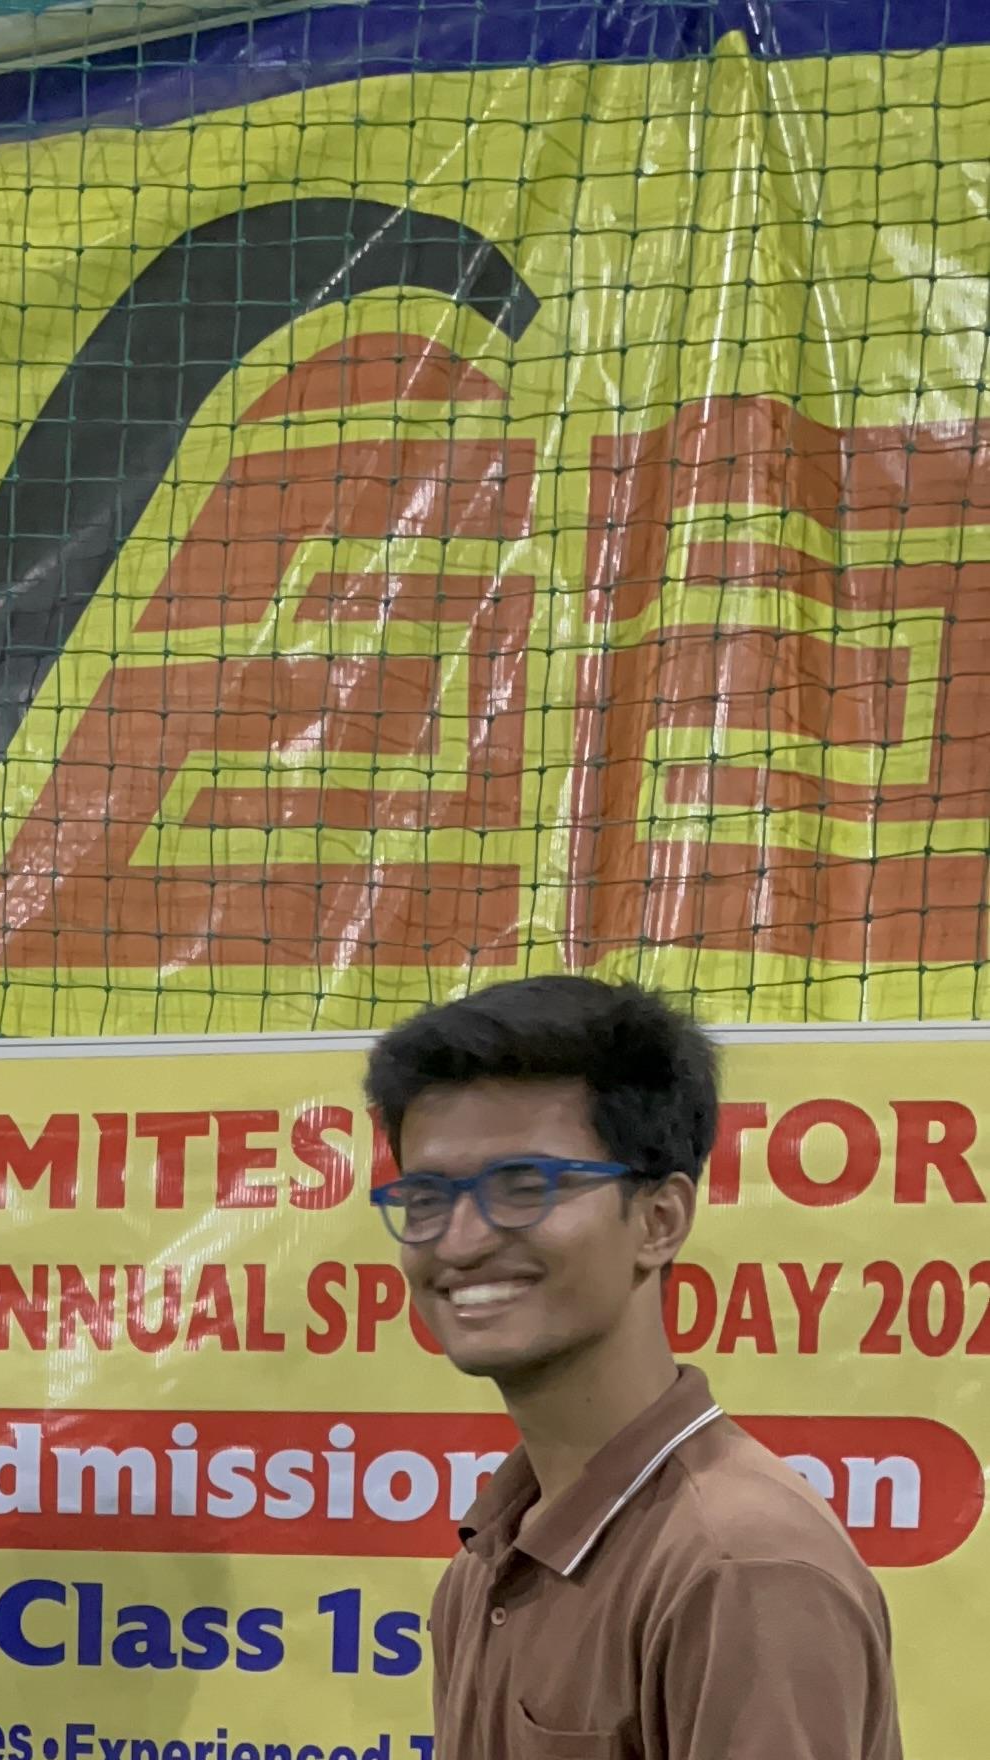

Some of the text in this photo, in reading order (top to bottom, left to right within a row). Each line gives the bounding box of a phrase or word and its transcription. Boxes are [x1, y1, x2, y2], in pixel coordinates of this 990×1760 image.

[306, 1260, 446, 1356] SP
[664, 1262, 843, 1355] DAY
[317, 1588, 432, 1677] 1s
